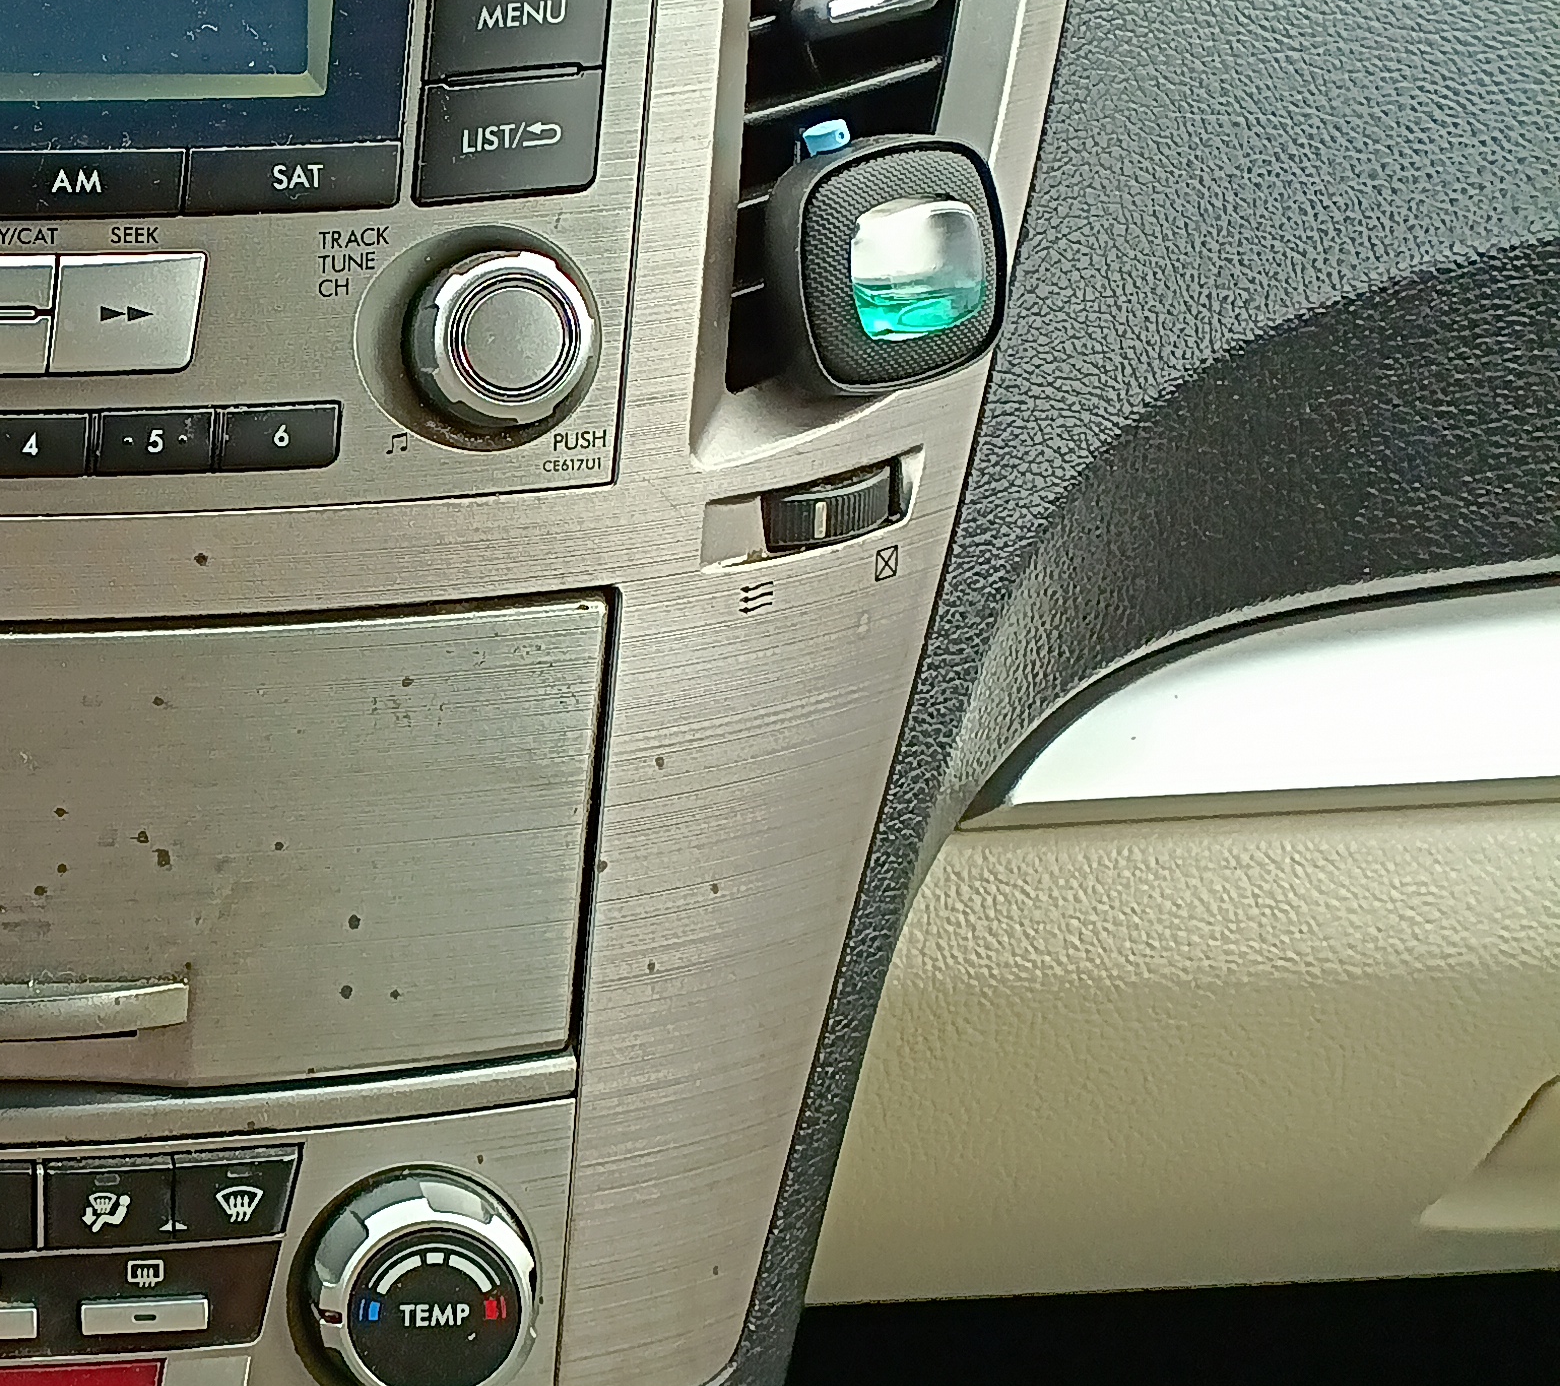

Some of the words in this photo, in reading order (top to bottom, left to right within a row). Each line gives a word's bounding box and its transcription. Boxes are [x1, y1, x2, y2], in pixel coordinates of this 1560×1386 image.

[51, 168, 102, 193] AM
[272, 164, 324, 190] SAT
[110, 226, 159, 244] SEEK
[318, 225, 390, 250] TRACK
[317, 250, 376, 274] TUNE
[318, 277, 350, 298] CH
[21, 432, 39, 456] 4
[147, 429, 164, 453] 5
[273, 424, 289, 447] 6
[552, 430, 607, 452] PUSH
[542, 456, 602, 473] CE617U1
[399, 1303, 470, 1328] TEMP
